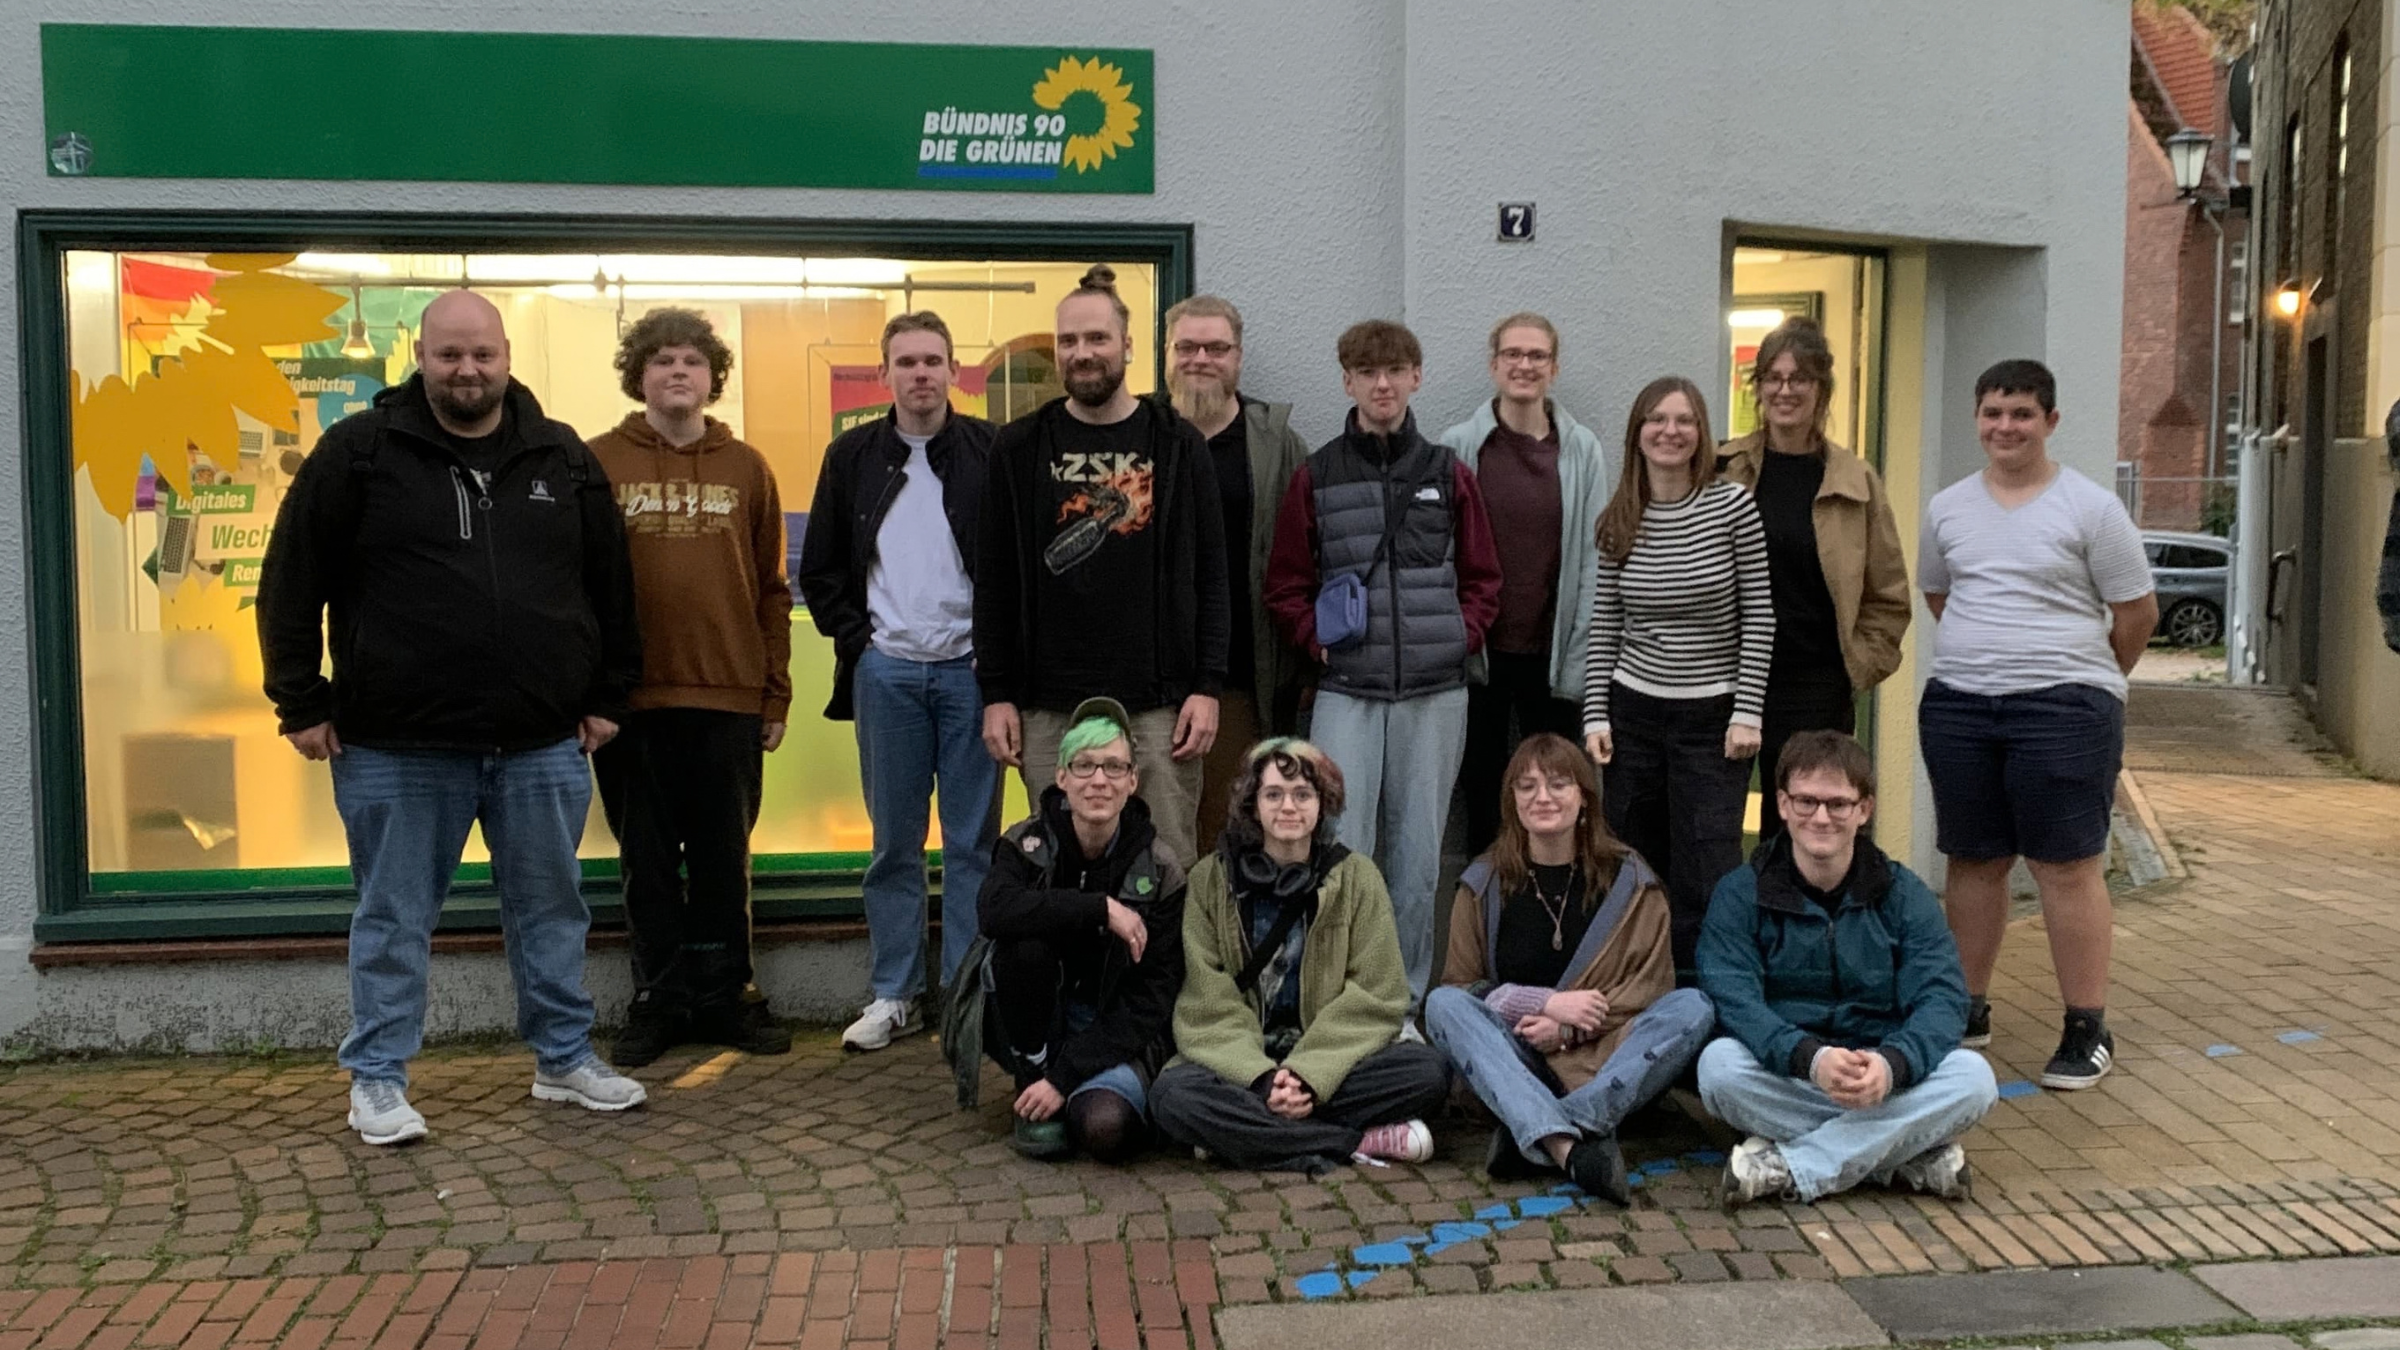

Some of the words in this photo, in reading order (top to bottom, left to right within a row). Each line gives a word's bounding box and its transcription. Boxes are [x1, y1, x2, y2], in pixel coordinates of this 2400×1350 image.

[923, 106, 1028, 136] BÜNDNIS
[1033, 114, 1066, 137] 90
[919, 139, 959, 161] DIE
[966, 135, 1062, 164] GRÜNEN
[1508, 207, 1525, 236] 7
[1062, 452, 1141, 483] ZSK
